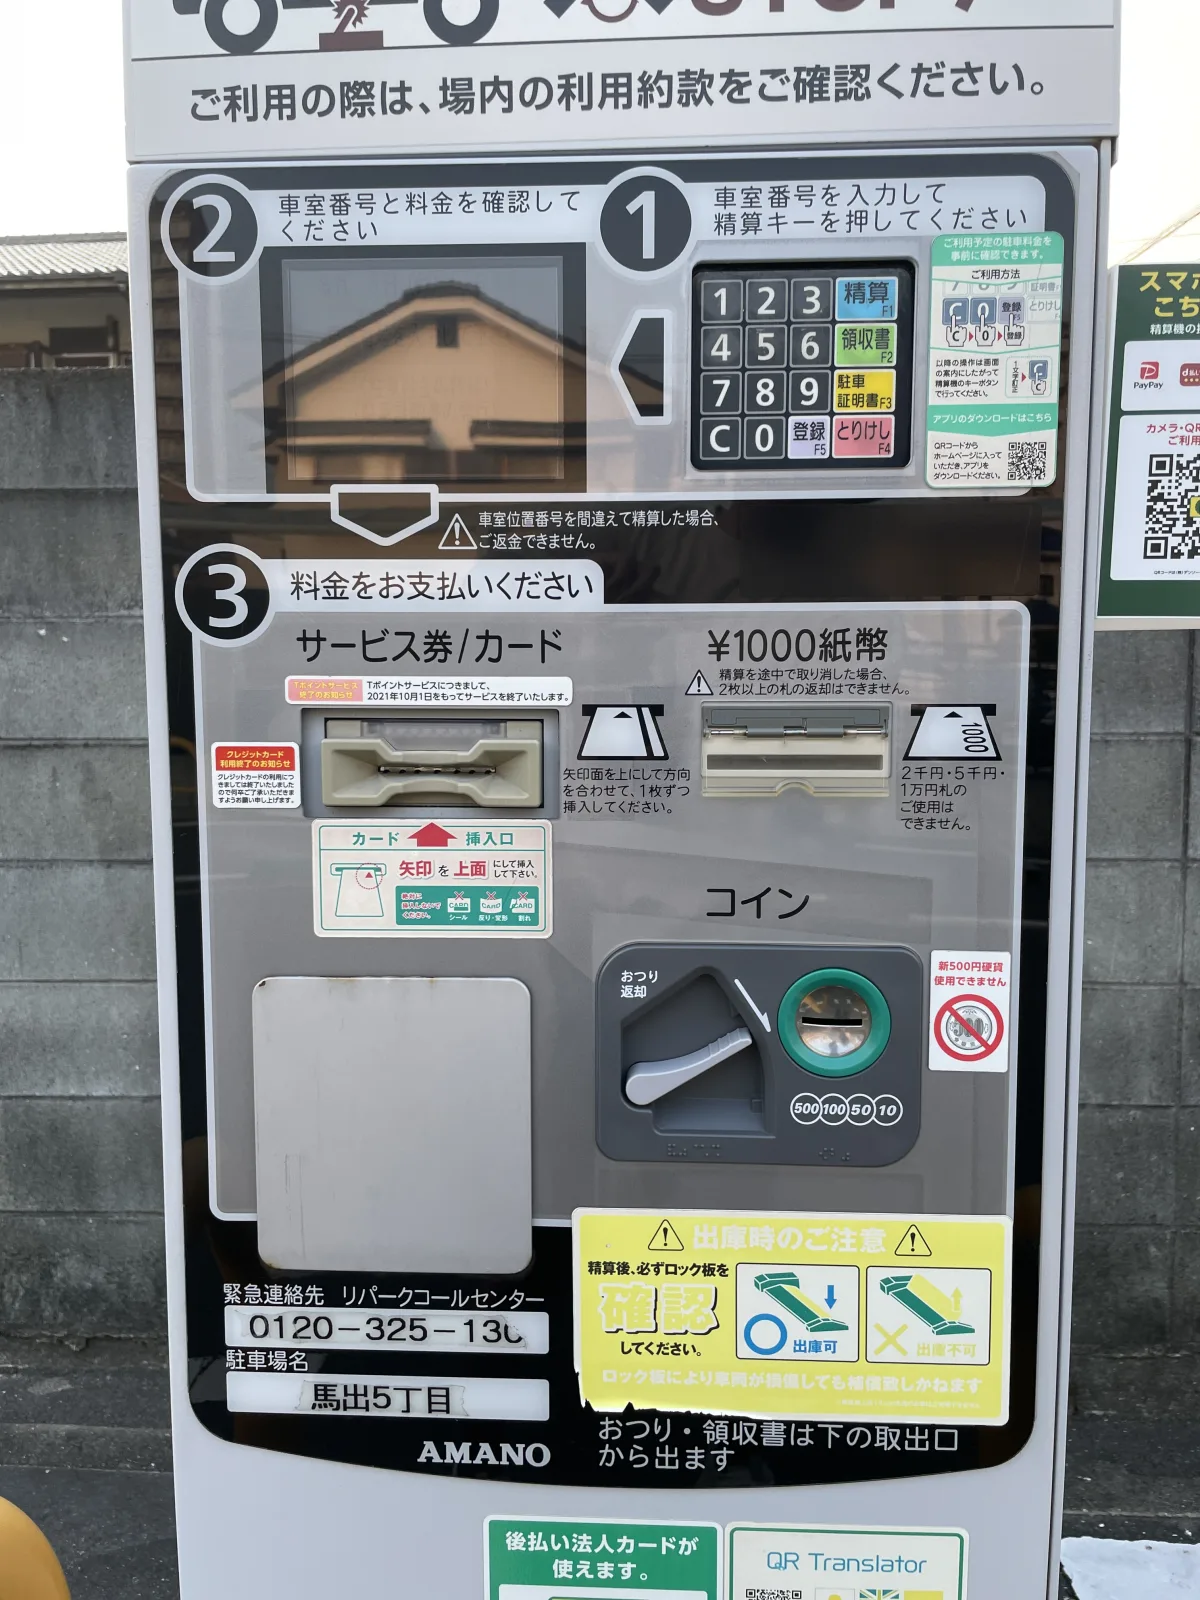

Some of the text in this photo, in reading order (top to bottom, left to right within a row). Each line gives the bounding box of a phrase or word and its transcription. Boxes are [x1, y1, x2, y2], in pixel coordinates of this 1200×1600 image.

[190, 62, 1044, 122] ご利用の際は、場内の利用約款をご確認ください。
[279, 190, 581, 217] 車室番号と料金を確認して
[714, 183, 947, 209] 車室番号を入力して
[192, 194, 236, 263] 2
[625, 191, 655, 259] 1
[714, 207, 1028, 236] 精算キーを押してください
[280, 220, 379, 242] ください
[944, 236, 1052, 248] ご利用予定の駐車料金を
[951, 249, 1043, 261] 事前に確認できます。
[972, 269, 1020, 280] ご利用方法
[757, 287, 776, 315] 2
[802, 286, 820, 314] 3
[844, 281, 889, 304] 精算
[714, 288, 727, 315] 1
[1002, 302, 1021, 312] 登録
[882, 306, 893, 317] F1
[842, 328, 890, 350] 領収書
[952, 331, 960, 341] C
[711, 333, 731, 361] 4
[757, 332, 775, 361] 5
[801, 331, 820, 360] 6
[881, 351, 893, 363] F2
[837, 374, 865, 389] 駐車
[935, 368, 999, 378] の案内にしたがって
[800, 377, 819, 406] 9
[935, 379, 999, 388] 精算機のキーボタン
[1133, 381, 1163, 390] PayPay
[712, 379, 731, 407] 7
[756, 378, 775, 407] 8
[837, 393, 892, 409] 証明書 F3
[935, 390, 988, 398] で行ってください。
[933, 413, 1052, 424] アプリのダウンロードはこちら
[709, 424, 731, 452] C
[755, 424, 774, 452] 0
[793, 422, 825, 441] 登録
[837, 420, 890, 441] とりけし
[814, 444, 826, 456] F5
[878, 442, 891, 455] F4
[934, 442, 978, 450] QRコードから
[934, 451, 1002, 460] ホームページに入って
[933, 462, 989, 470] いただき、アプリを
[933, 472, 1001, 480] ダウンロードください。
[478, 509, 720, 528] 車室位置番号を間違えて精算した場合、
[479, 532, 597, 550] ご返金できません。
[290, 570, 594, 602] 料金をお支払いください
[208, 563, 249, 628] 3
[297, 627, 563, 664] サービス券/カード
[707, 627, 888, 663] ¥1000紙幣
[719, 668, 887, 682] 精算を途中で取り消した場合、
[294, 681, 358, 690] Tポイントサービス
[367, 681, 490, 690] Tポイントサービスにつきまして、
[719, 681, 912, 697] 2枚以上の札の返却はできません。
[299, 690, 353, 699] 終了のお知らせ
[367, 691, 570, 702] 2021年10月1日をもってサービスを終了いたします。
[962, 721, 990, 753] 1000
[227, 750, 284, 759] クレジットカード
[220, 760, 291, 768] 利用終了のお知らせ
[563, 767, 691, 781] 矢印面を上にして方向
[563, 783, 690, 798] を合わせて、1枚ずつ
[901, 783, 967, 797] 1万円札の
[563, 800, 674, 815] 挿入してください。
[900, 800, 954, 814] ご使用は
[900, 817, 972, 831] できません。
[353, 831, 514, 846] カード 挿入口
[399, 860, 486, 877] 矢印 を 上面
[494, 860, 535, 869] にして挿入
[494, 869, 538, 879] して下さい。
[706, 887, 809, 919] コイン
[938, 961, 1004, 973] 新500円硬貨
[621, 969, 659, 983] おつり
[934, 975, 1007, 987] 使用できません
[621, 985, 647, 999] 返却
[794, 1102, 897, 1117] 500 100 50 10
[693, 1223, 887, 1254] 出庫時のご注意
[588, 1261, 729, 1278] 精算後、必ずロック板を
[223, 1283, 545, 1310] 緊急連絡先 リパークコールセンター
[598, 1283, 719, 1336] 確認
[620, 1341, 703, 1358] してください。
[793, 1339, 838, 1355] 出庫可
[916, 1342, 977, 1359] 出庫不可
[226, 1350, 309, 1371] 駐車場名
[311, 1384, 451, 1415] 馬出5丁目
[598, 1417, 959, 1452] おつり・領収書は下の取出口
[417, 1441, 551, 1467] AMANO
[598, 1445, 735, 1471] から出ます
[505, 1530, 700, 1557] 後払い法人カードが
[552, 1559, 649, 1581] 使えます。
[767, 1551, 927, 1574] QR Translator
